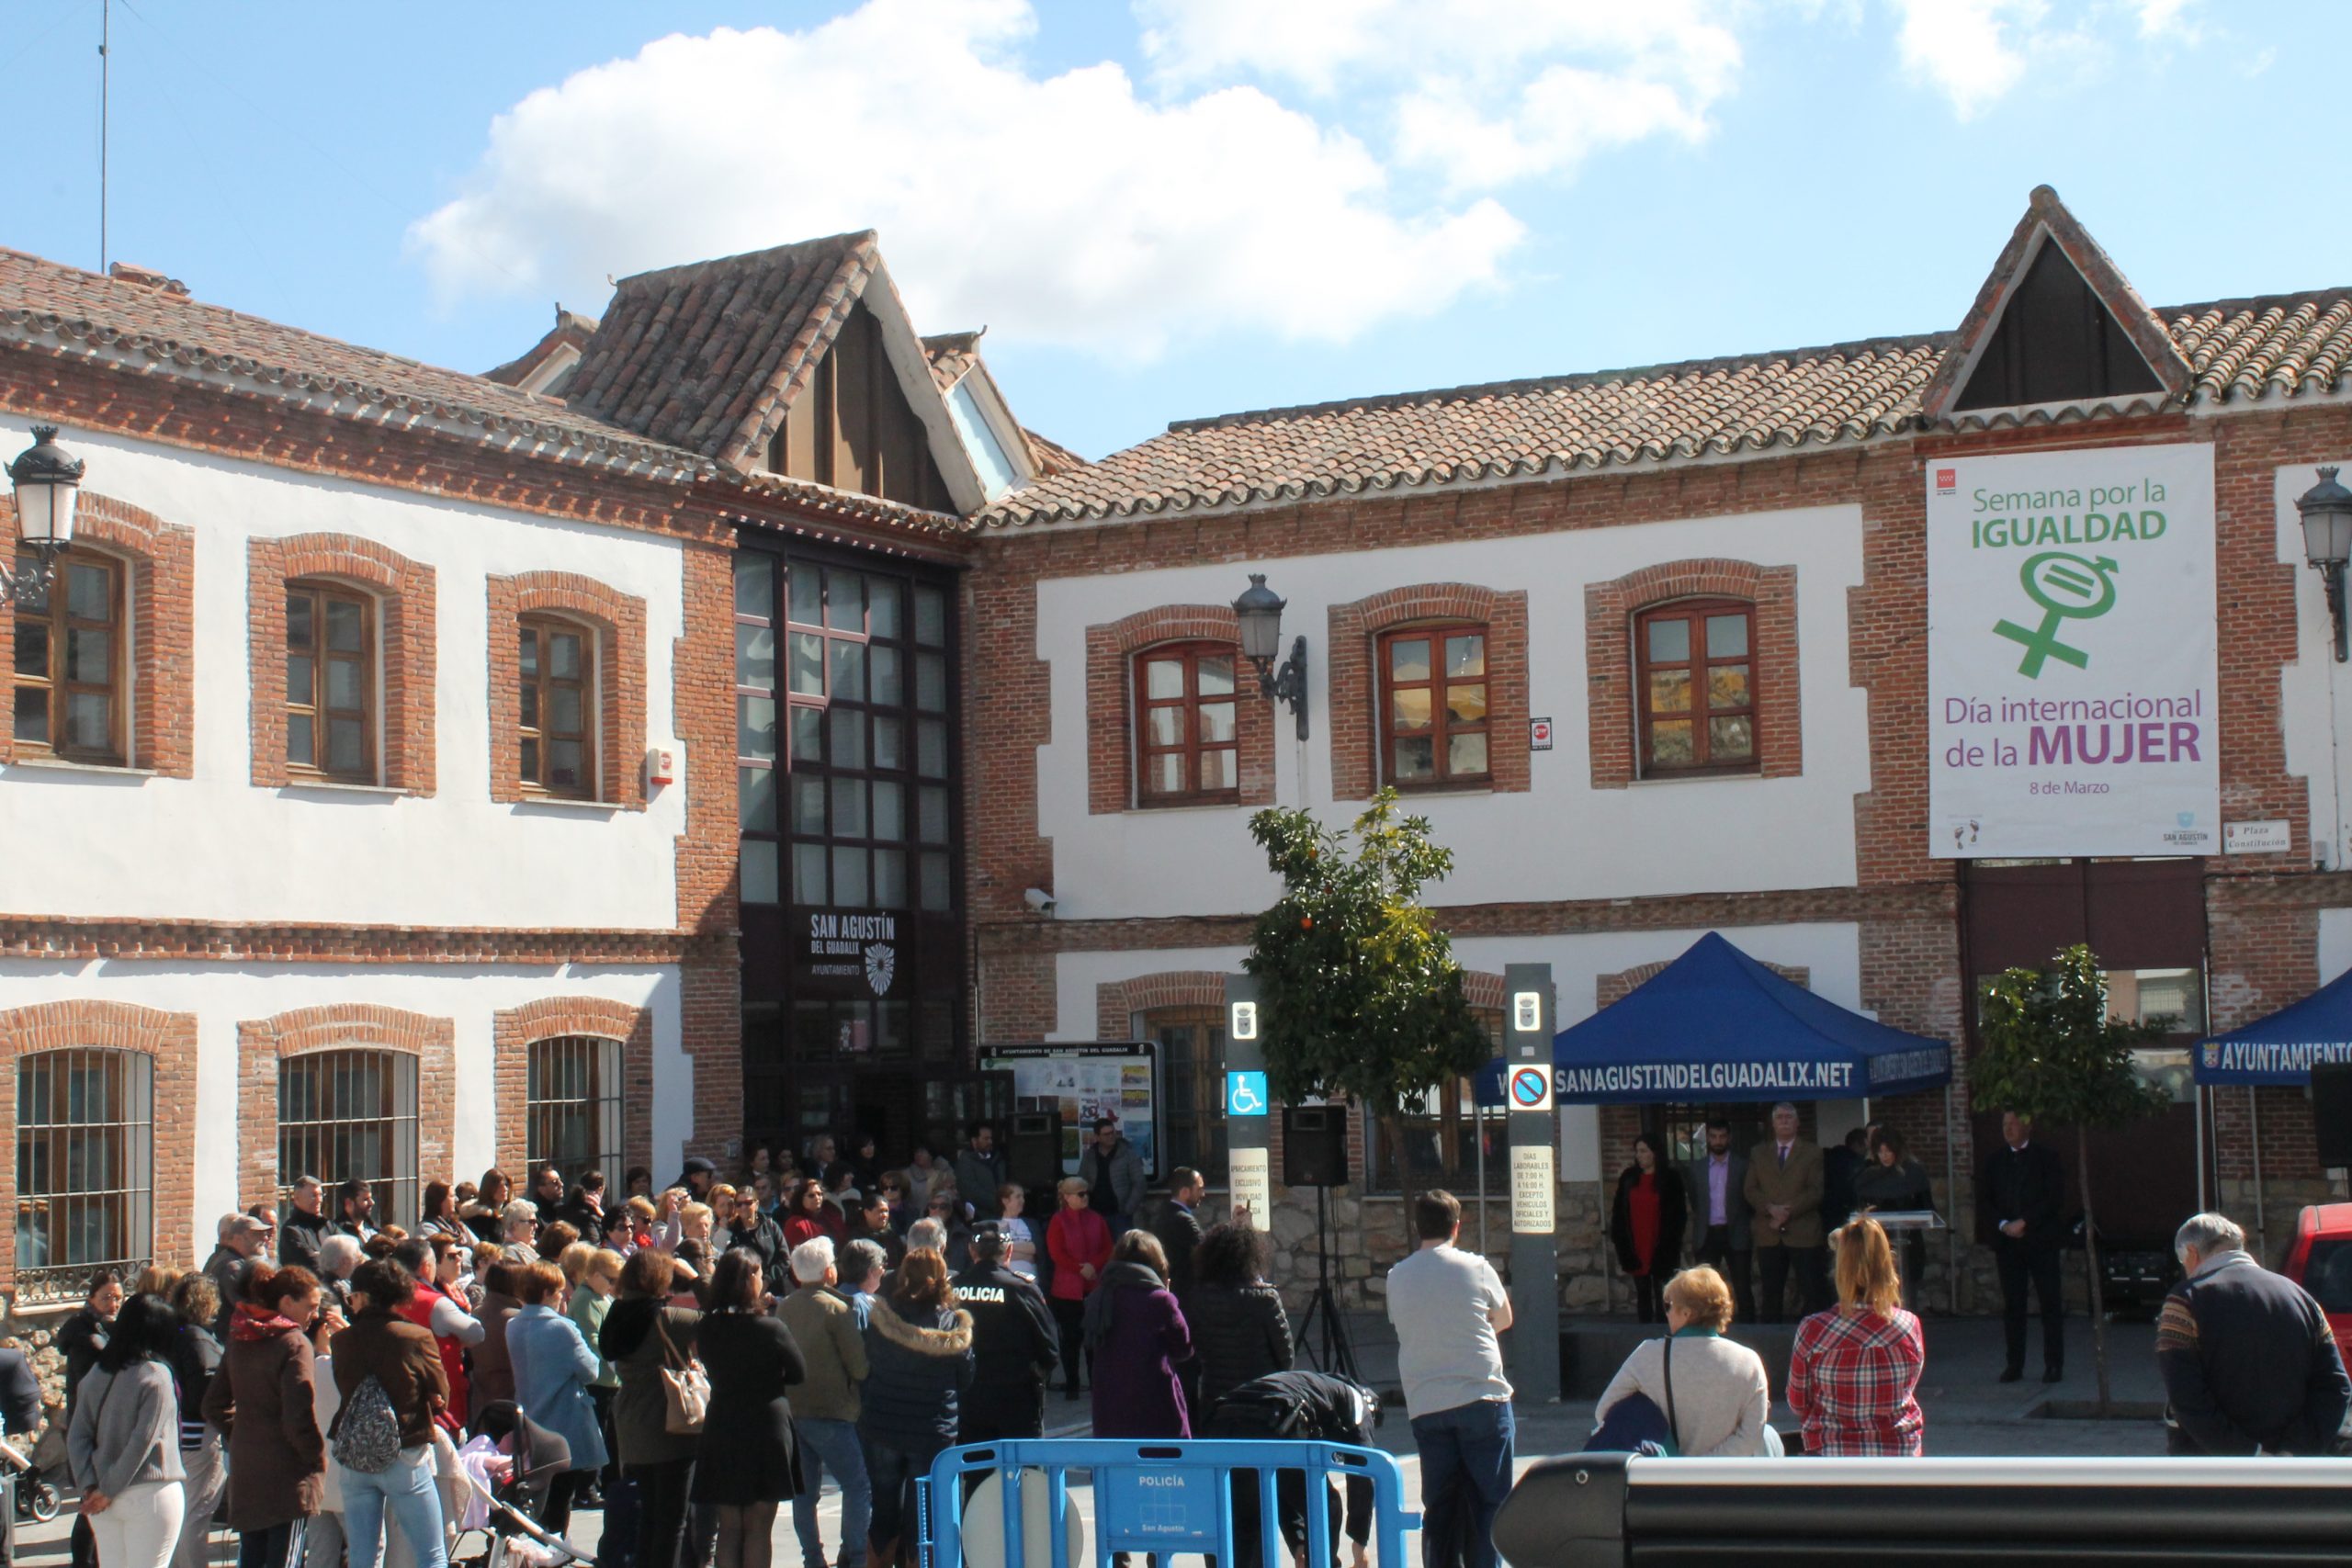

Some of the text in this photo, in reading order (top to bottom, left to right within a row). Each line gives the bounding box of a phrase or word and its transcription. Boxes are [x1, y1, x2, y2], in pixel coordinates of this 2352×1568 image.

[1973, 479, 2166, 513] Semana por la
[1973, 510, 2167, 548] IGUALDAD
[1946, 690, 2200, 724] Día internacional
[1946, 722, 2200, 767] de la MUJER
[2030, 780, 2109, 795] 8 de Marzo
[2244, 827, 2268, 835] Plaza
[811, 912, 895, 941] SAN AGUSTÍN
[811, 941, 860, 955] DEL GUADALIX
[811, 964, 860, 976] AYUNTAMIENTO
[1235, 1179, 1261, 1187] EXCLUSIVO
[1139, 1474, 1185, 1486] POLICÍA
